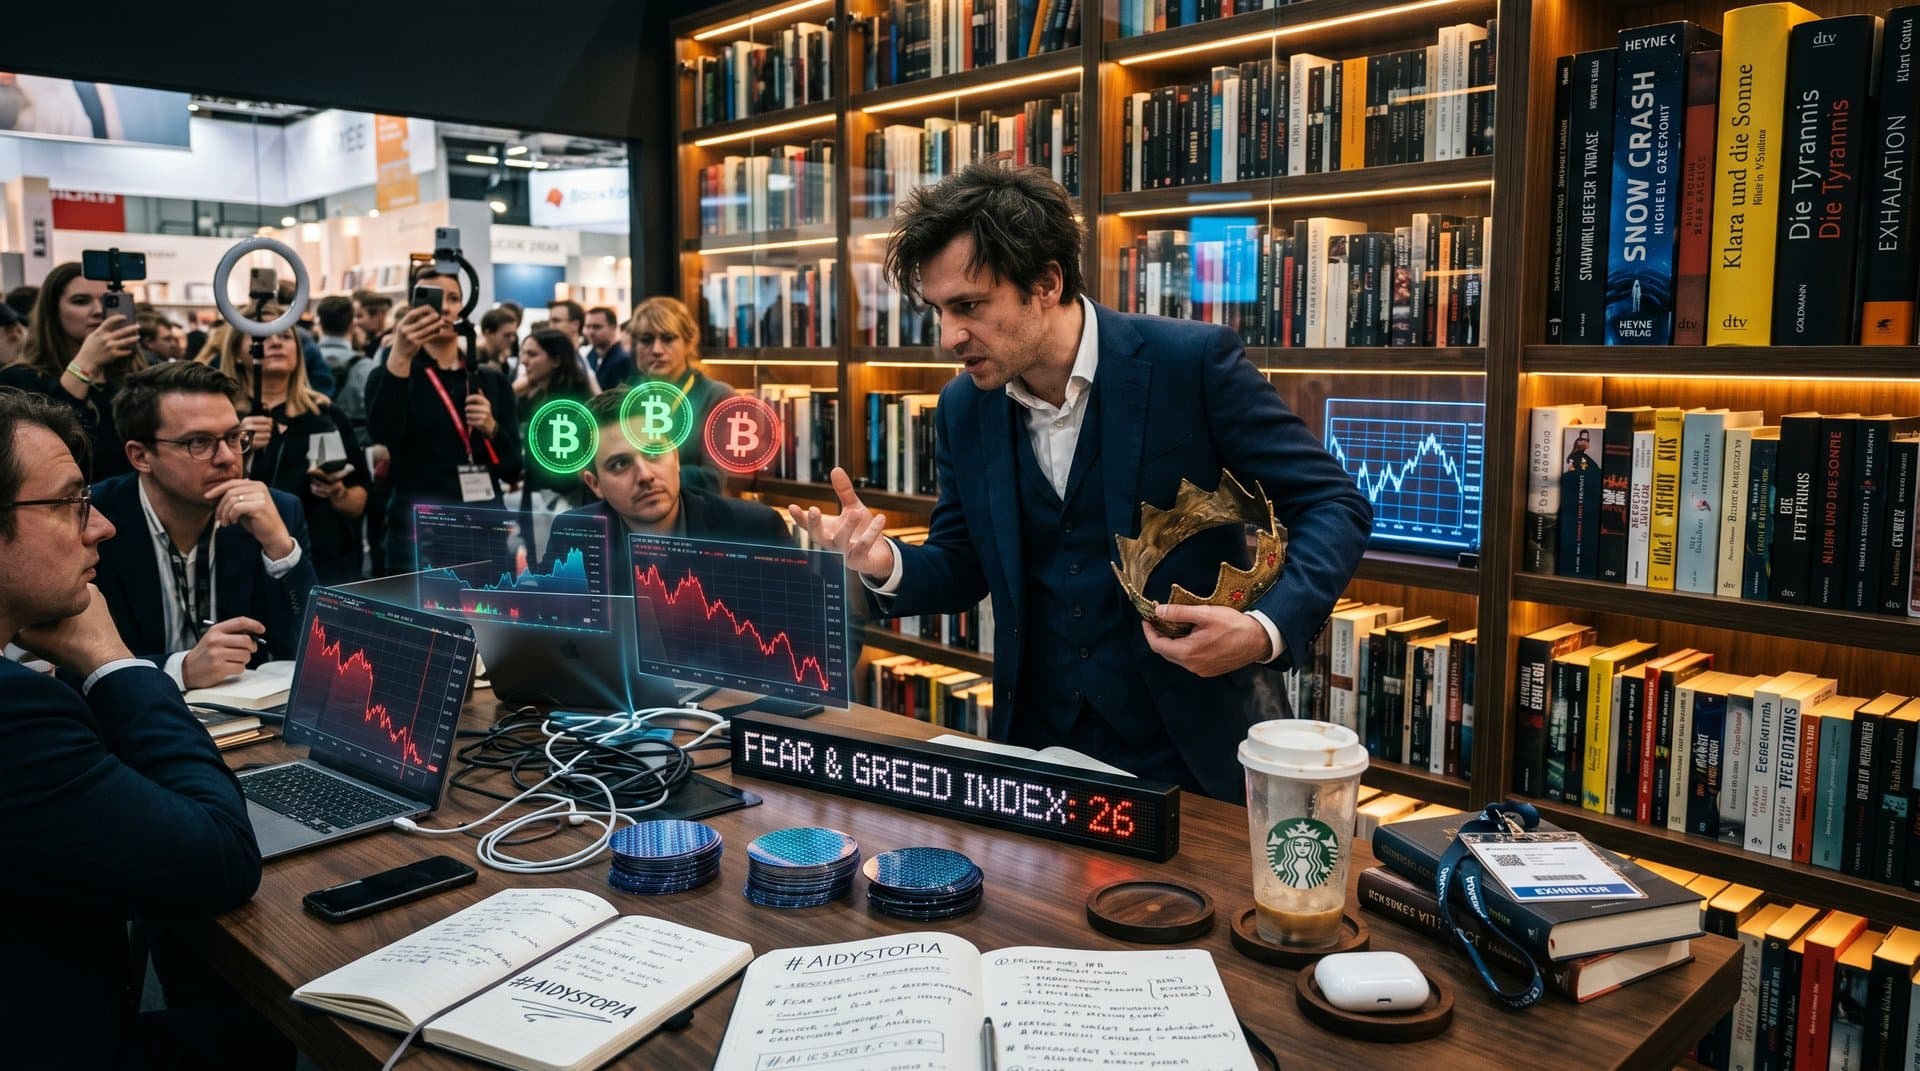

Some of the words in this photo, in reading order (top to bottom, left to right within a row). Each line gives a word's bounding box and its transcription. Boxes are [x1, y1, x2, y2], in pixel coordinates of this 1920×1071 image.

[1625, 35, 1668, 51] HEYNE
[1732, 63, 1753, 127] Sonne
[1628, 71, 1656, 168] CRASH
[1729, 133, 1749, 163] die
[1791, 89, 1822, 195] Tyrannis
[1821, 99, 1852, 195] Tyrannis
[1728, 168, 1747, 206] und
[1878, 114, 1907, 251] EXHALATION
[1623, 178, 1650, 262] SNOW
[1789, 201, 1813, 240] Die
[1819, 202, 1843, 240] Die
[1723, 213, 1745, 270] Klara
[1619, 320, 1653, 329] HEYNE
[1722, 314, 1748, 331] dtv
[1796, 284, 1807, 334] GOLDMANN
[1826, 479, 1838, 499] DIE
[1825, 502, 1837, 526] UND
[744, 731, 815, 775] FEAR
[825, 747, 843, 780] &
[852, 752, 952, 801] GREED
[1088, 795, 1135, 837] 26
[1533, 885, 1612, 897] EXHIBITOR
[509, 975, 638, 1019] #AIDYSTOPIA
